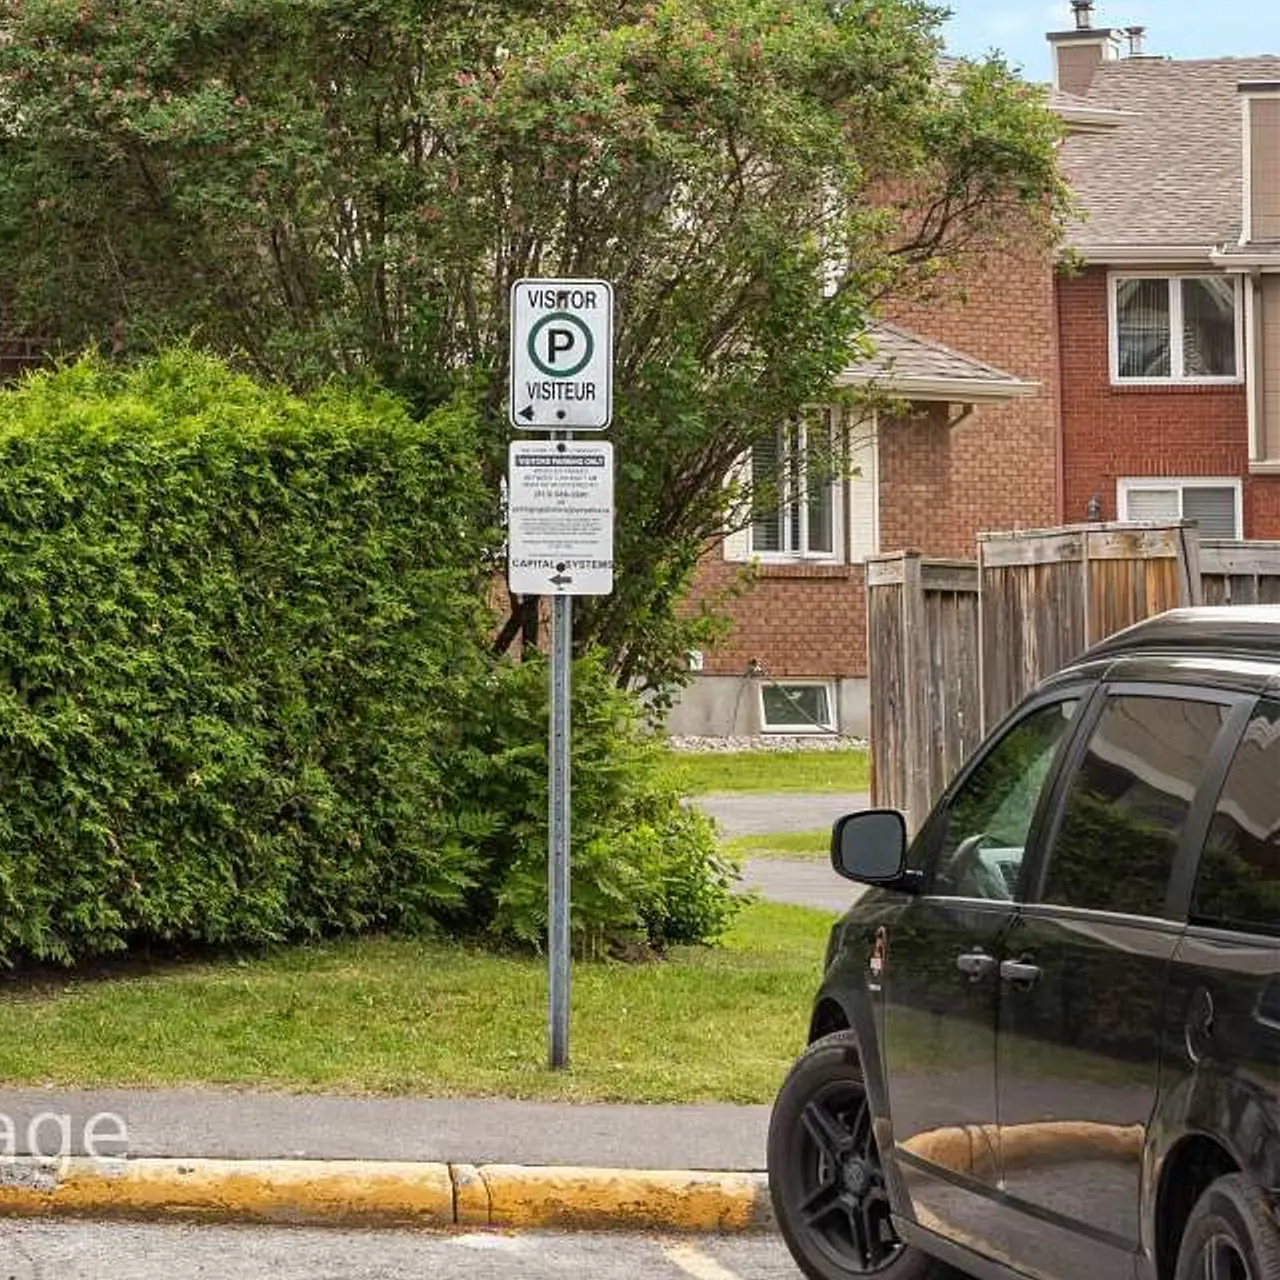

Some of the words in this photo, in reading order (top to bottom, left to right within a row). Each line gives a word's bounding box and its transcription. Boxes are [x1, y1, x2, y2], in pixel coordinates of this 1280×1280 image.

[527, 289, 597, 310] VISITOR
[547, 328, 575, 364] P
[526, 382, 596, 401] VISITEUR
